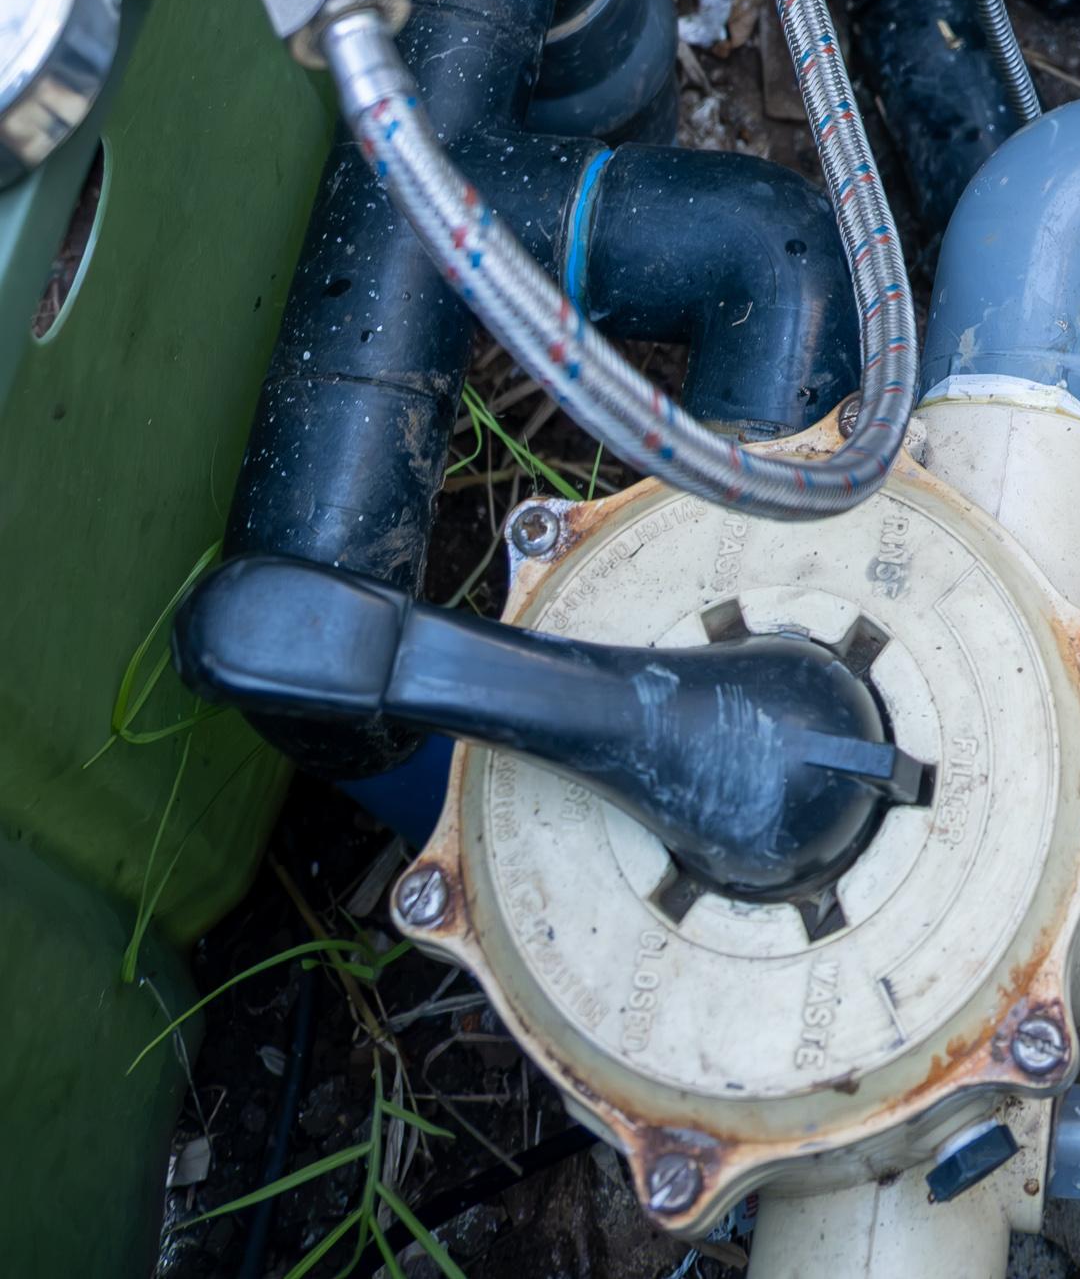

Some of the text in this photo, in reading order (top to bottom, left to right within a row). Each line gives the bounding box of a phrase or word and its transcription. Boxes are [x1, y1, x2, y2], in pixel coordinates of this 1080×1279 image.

[872, 516, 910, 599] RINSE
[939, 736, 978, 845] FILTER
[621, 929, 668, 1054] CLOSED
[794, 951, 840, 1071] WASTE
